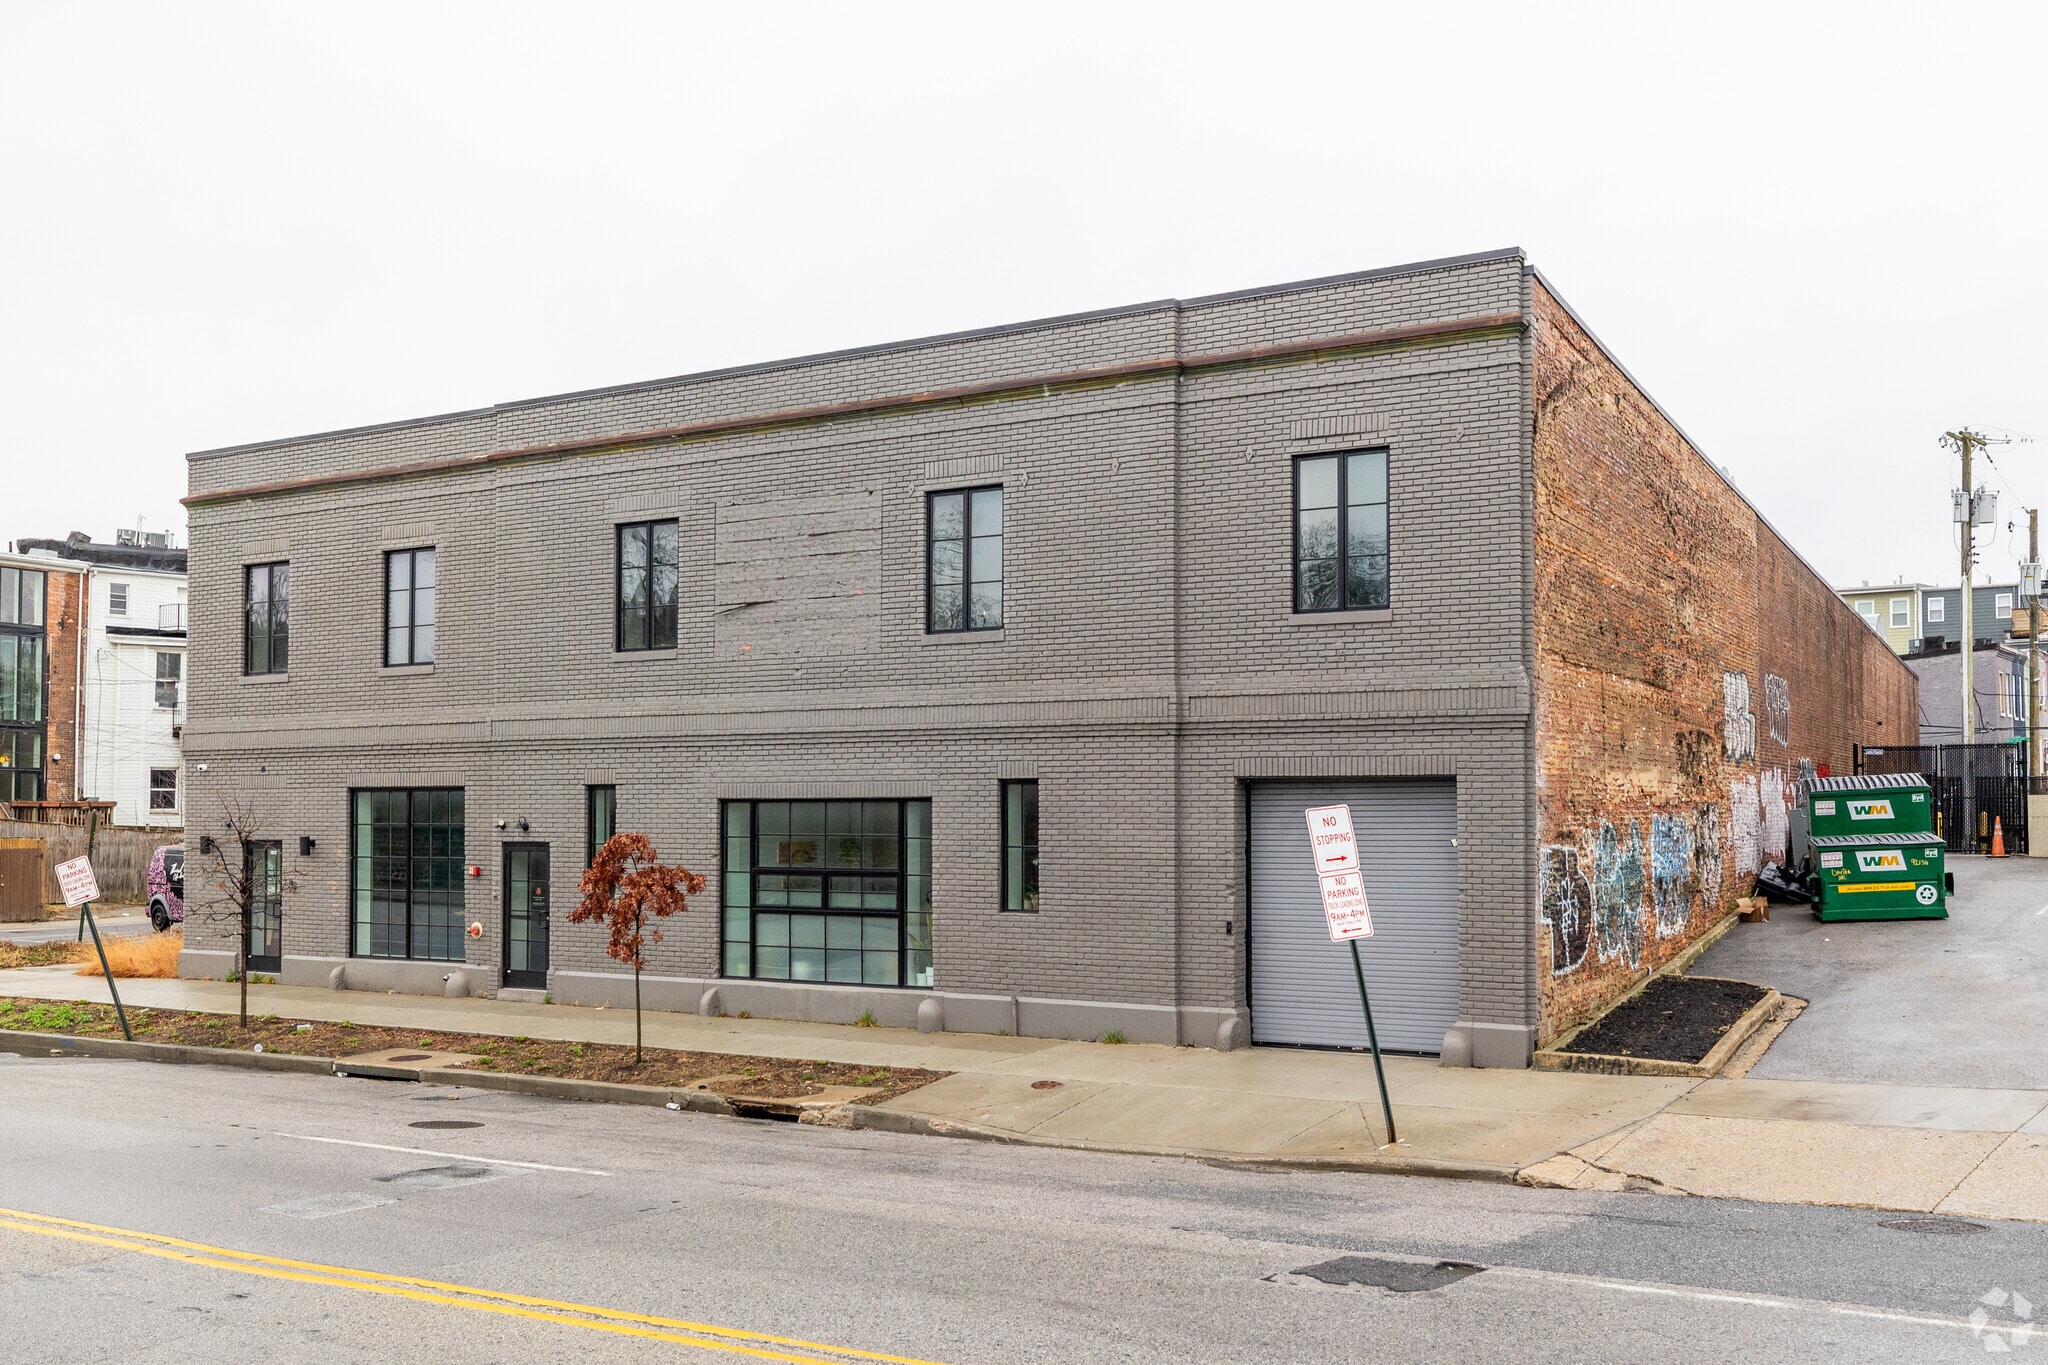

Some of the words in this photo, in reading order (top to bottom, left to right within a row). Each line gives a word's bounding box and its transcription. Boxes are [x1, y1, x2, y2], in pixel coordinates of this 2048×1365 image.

[1854, 805, 1889, 815] WM
[1322, 816, 1337, 827] NO
[1317, 832, 1351, 846] STOPPING
[1863, 856, 1899, 867] WM
[62, 867, 87, 880] PARKING
[1334, 876, 1347, 886] NO
[1327, 886, 1360, 900] PARKING
